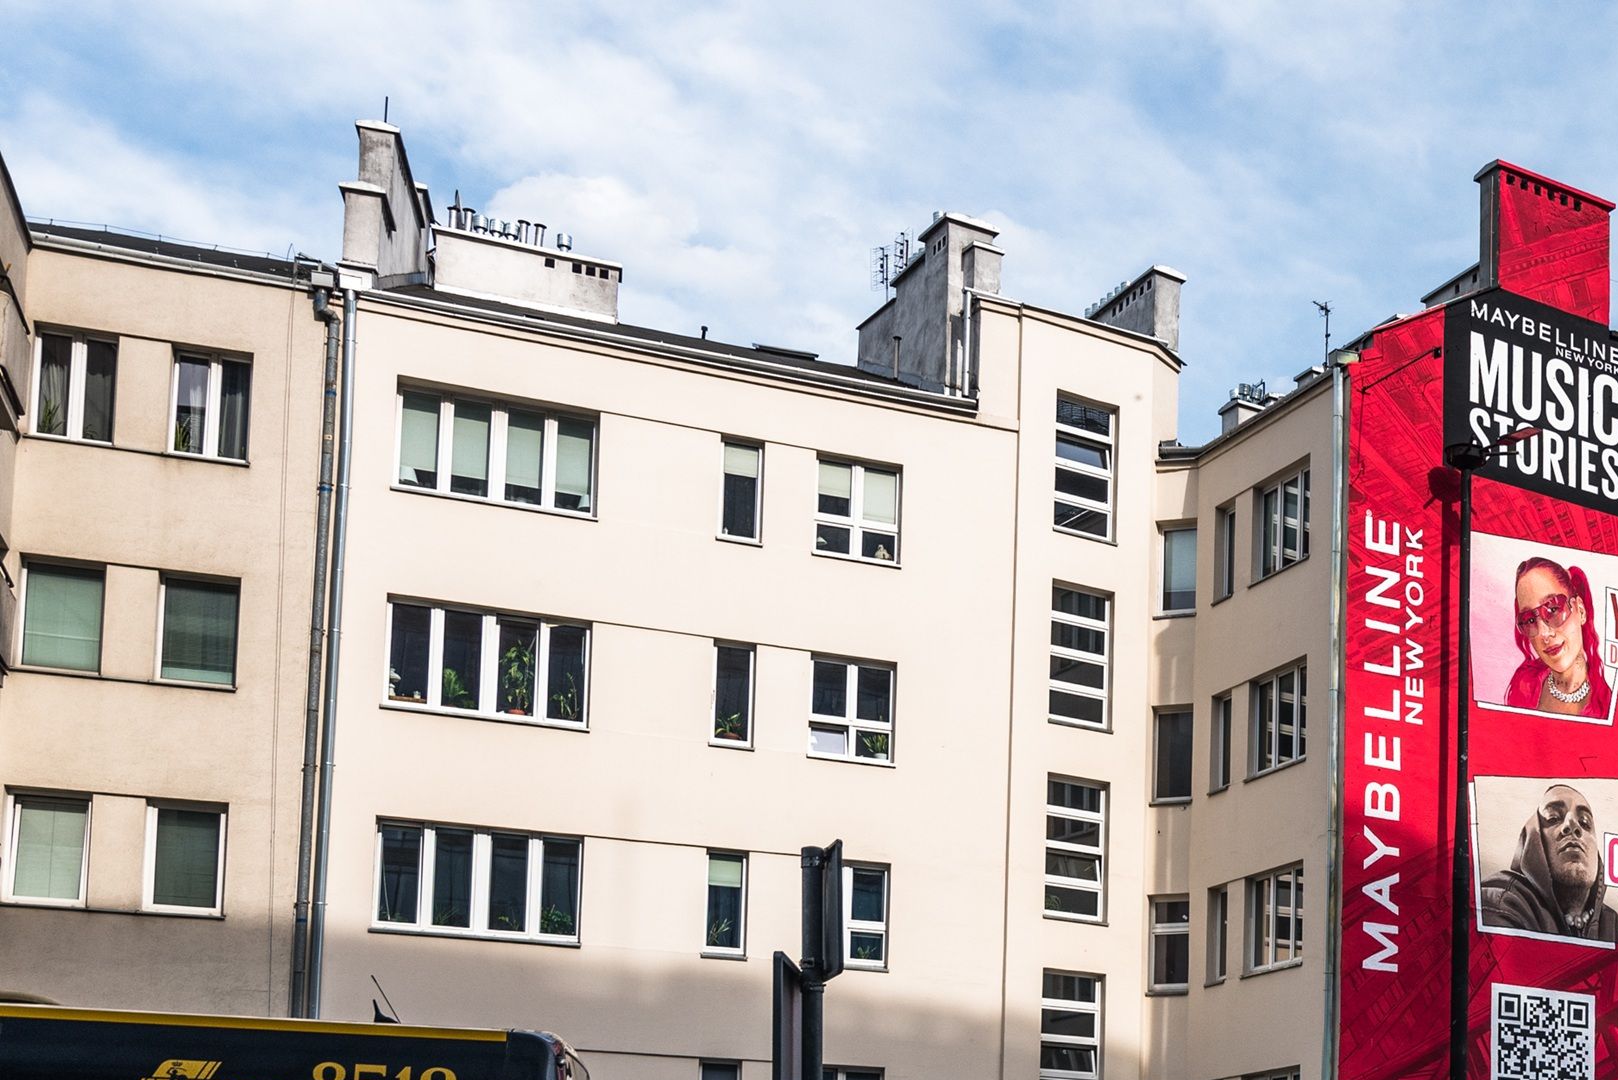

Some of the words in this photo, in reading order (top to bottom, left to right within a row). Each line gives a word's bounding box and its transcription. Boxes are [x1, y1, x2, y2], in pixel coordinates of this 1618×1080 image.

[1555, 347, 1585, 364] NEW
[1405, 525, 1424, 630] YORK
[1404, 637, 1424, 726] NEW
[1361, 514, 1401, 974] MAYBELLINE
